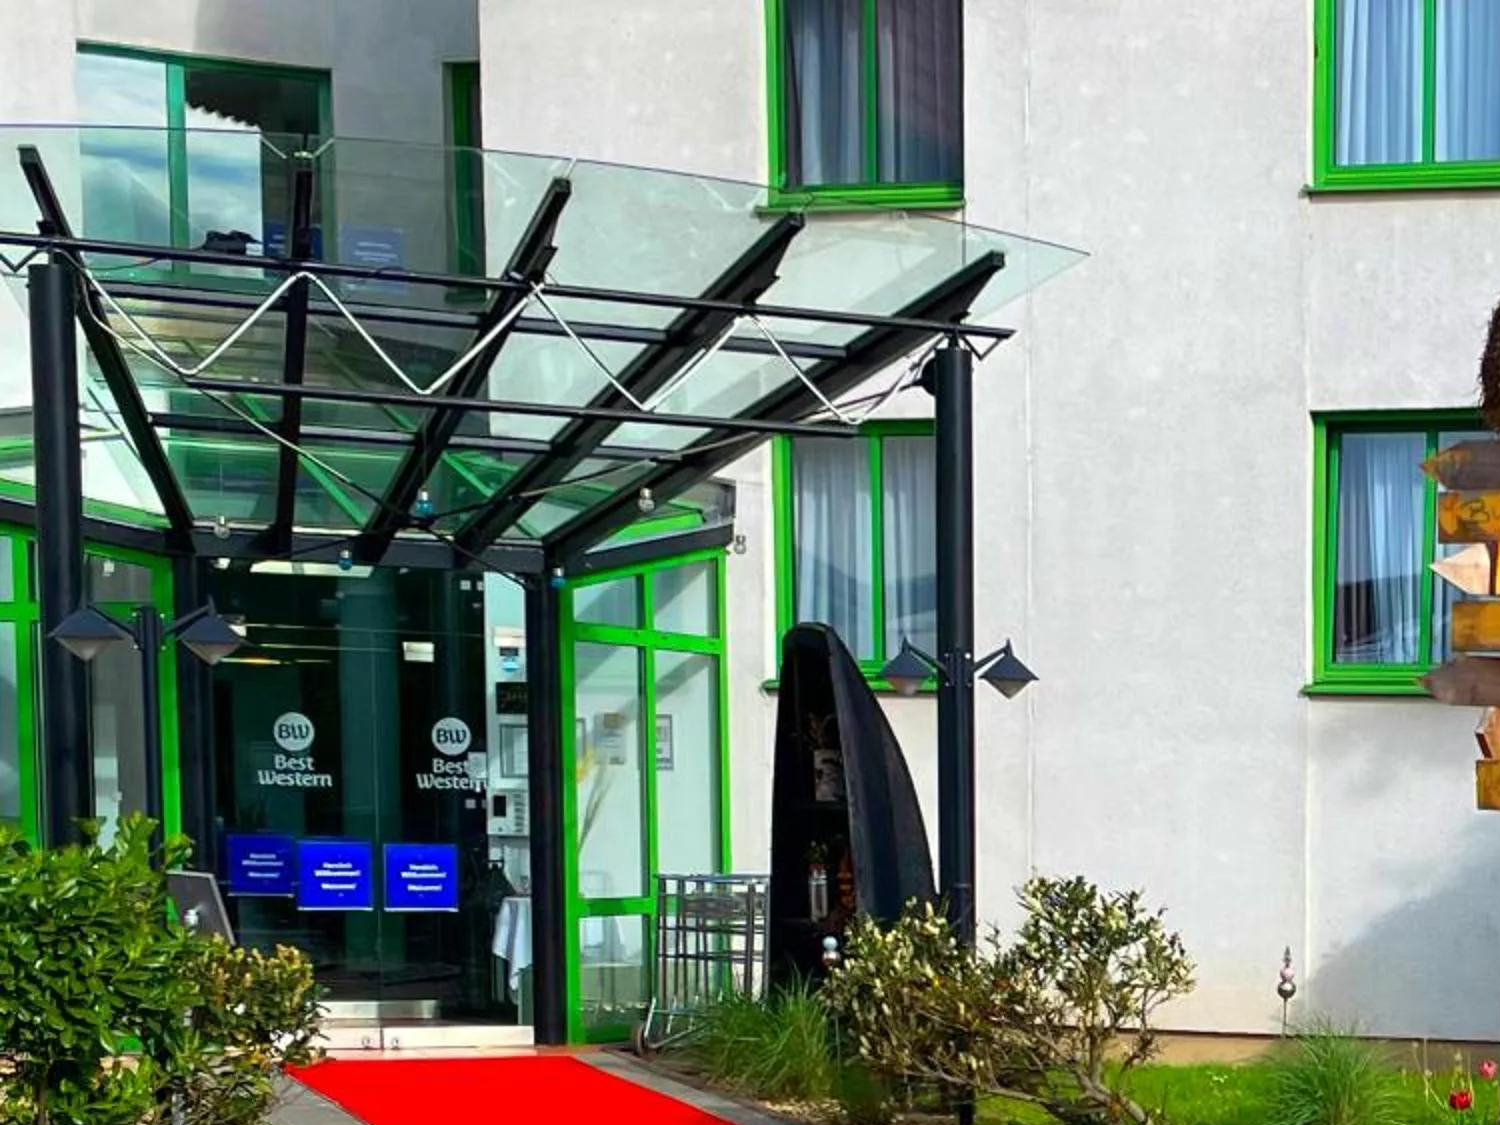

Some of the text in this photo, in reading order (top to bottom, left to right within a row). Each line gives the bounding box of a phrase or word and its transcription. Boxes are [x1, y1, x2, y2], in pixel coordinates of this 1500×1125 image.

[274, 753, 315, 771] Best
[432, 758, 472, 775] Best
[257, 769, 333, 787] Western
